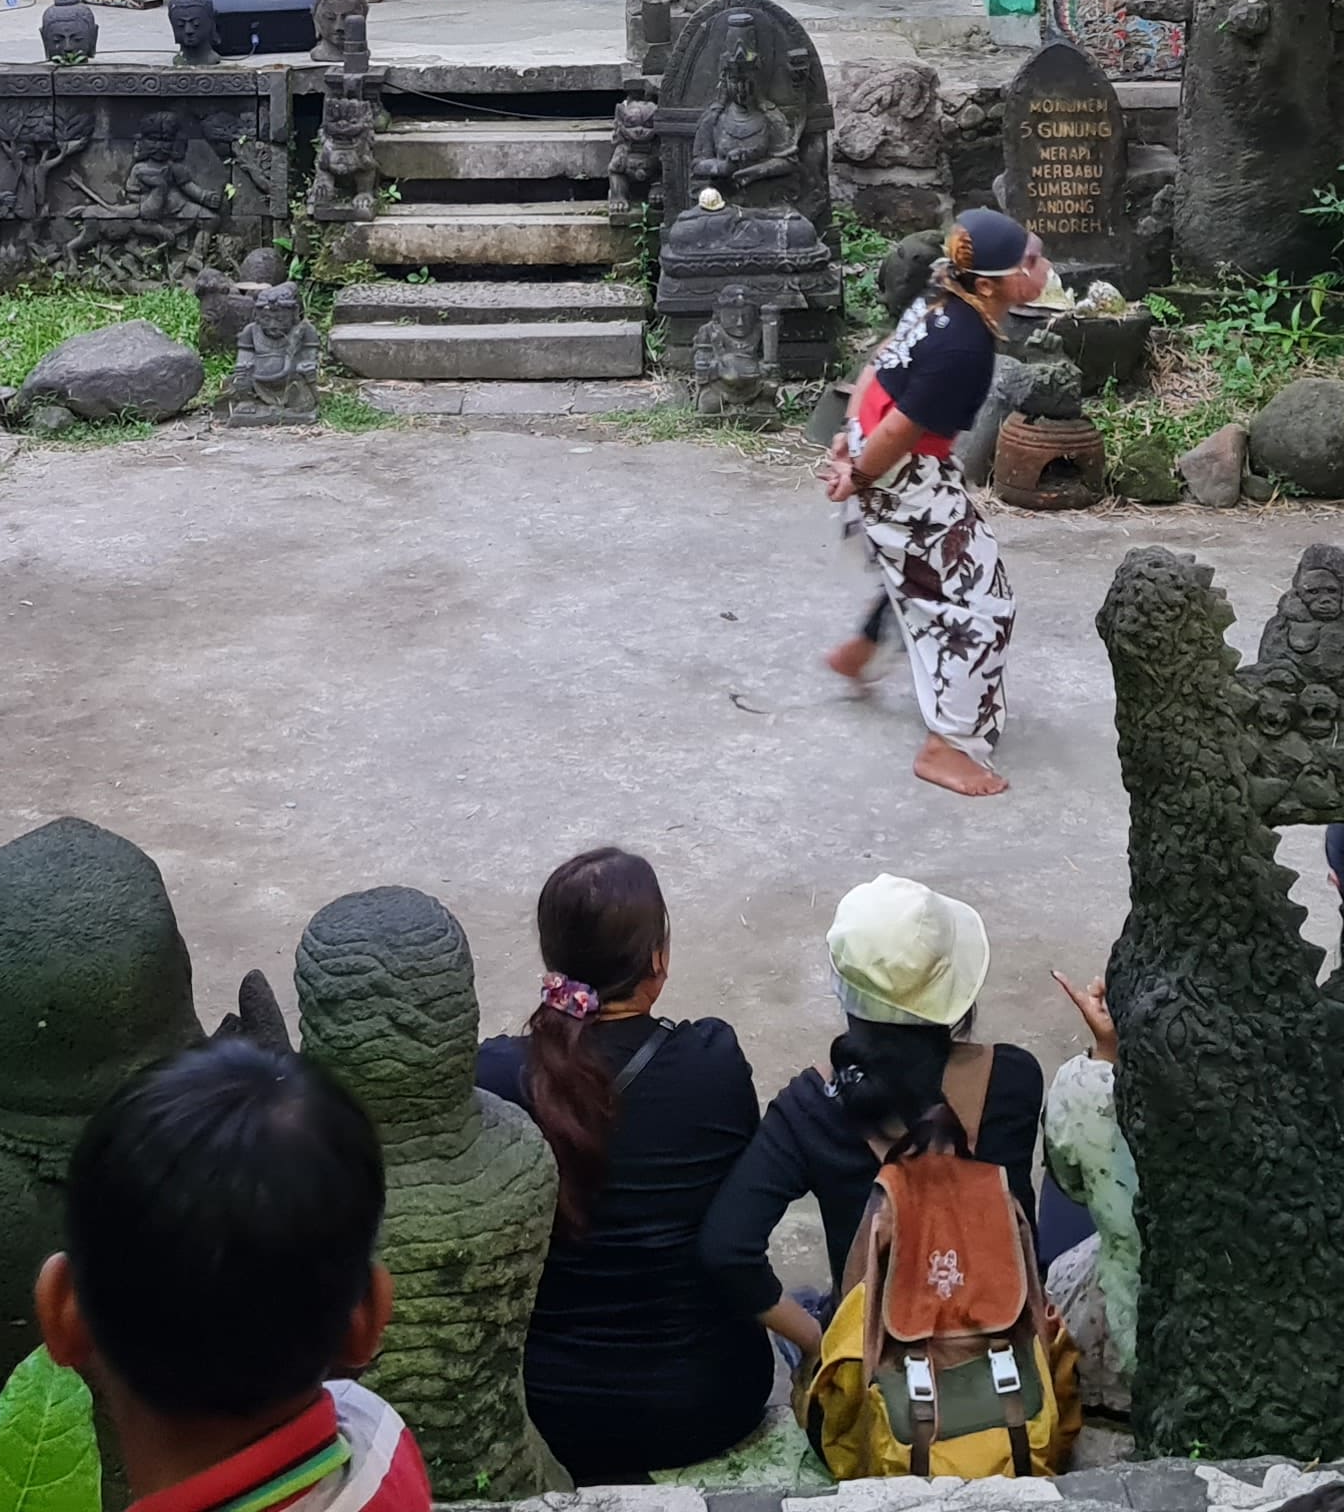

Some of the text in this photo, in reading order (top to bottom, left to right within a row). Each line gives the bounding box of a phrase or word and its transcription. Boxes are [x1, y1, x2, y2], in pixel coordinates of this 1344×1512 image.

[1029, 98, 1108, 113] MONUMEN
[1020, 121, 1112, 138] 5 GUNUNG
[1040, 146, 1091, 161] MERAPI
[1031, 164, 1103, 178] MERBABU
[1028, 182, 1101, 196] SUMBING
[1037, 199, 1095, 214] ANDONG
[1025, 218, 1102, 233] MENOREH
